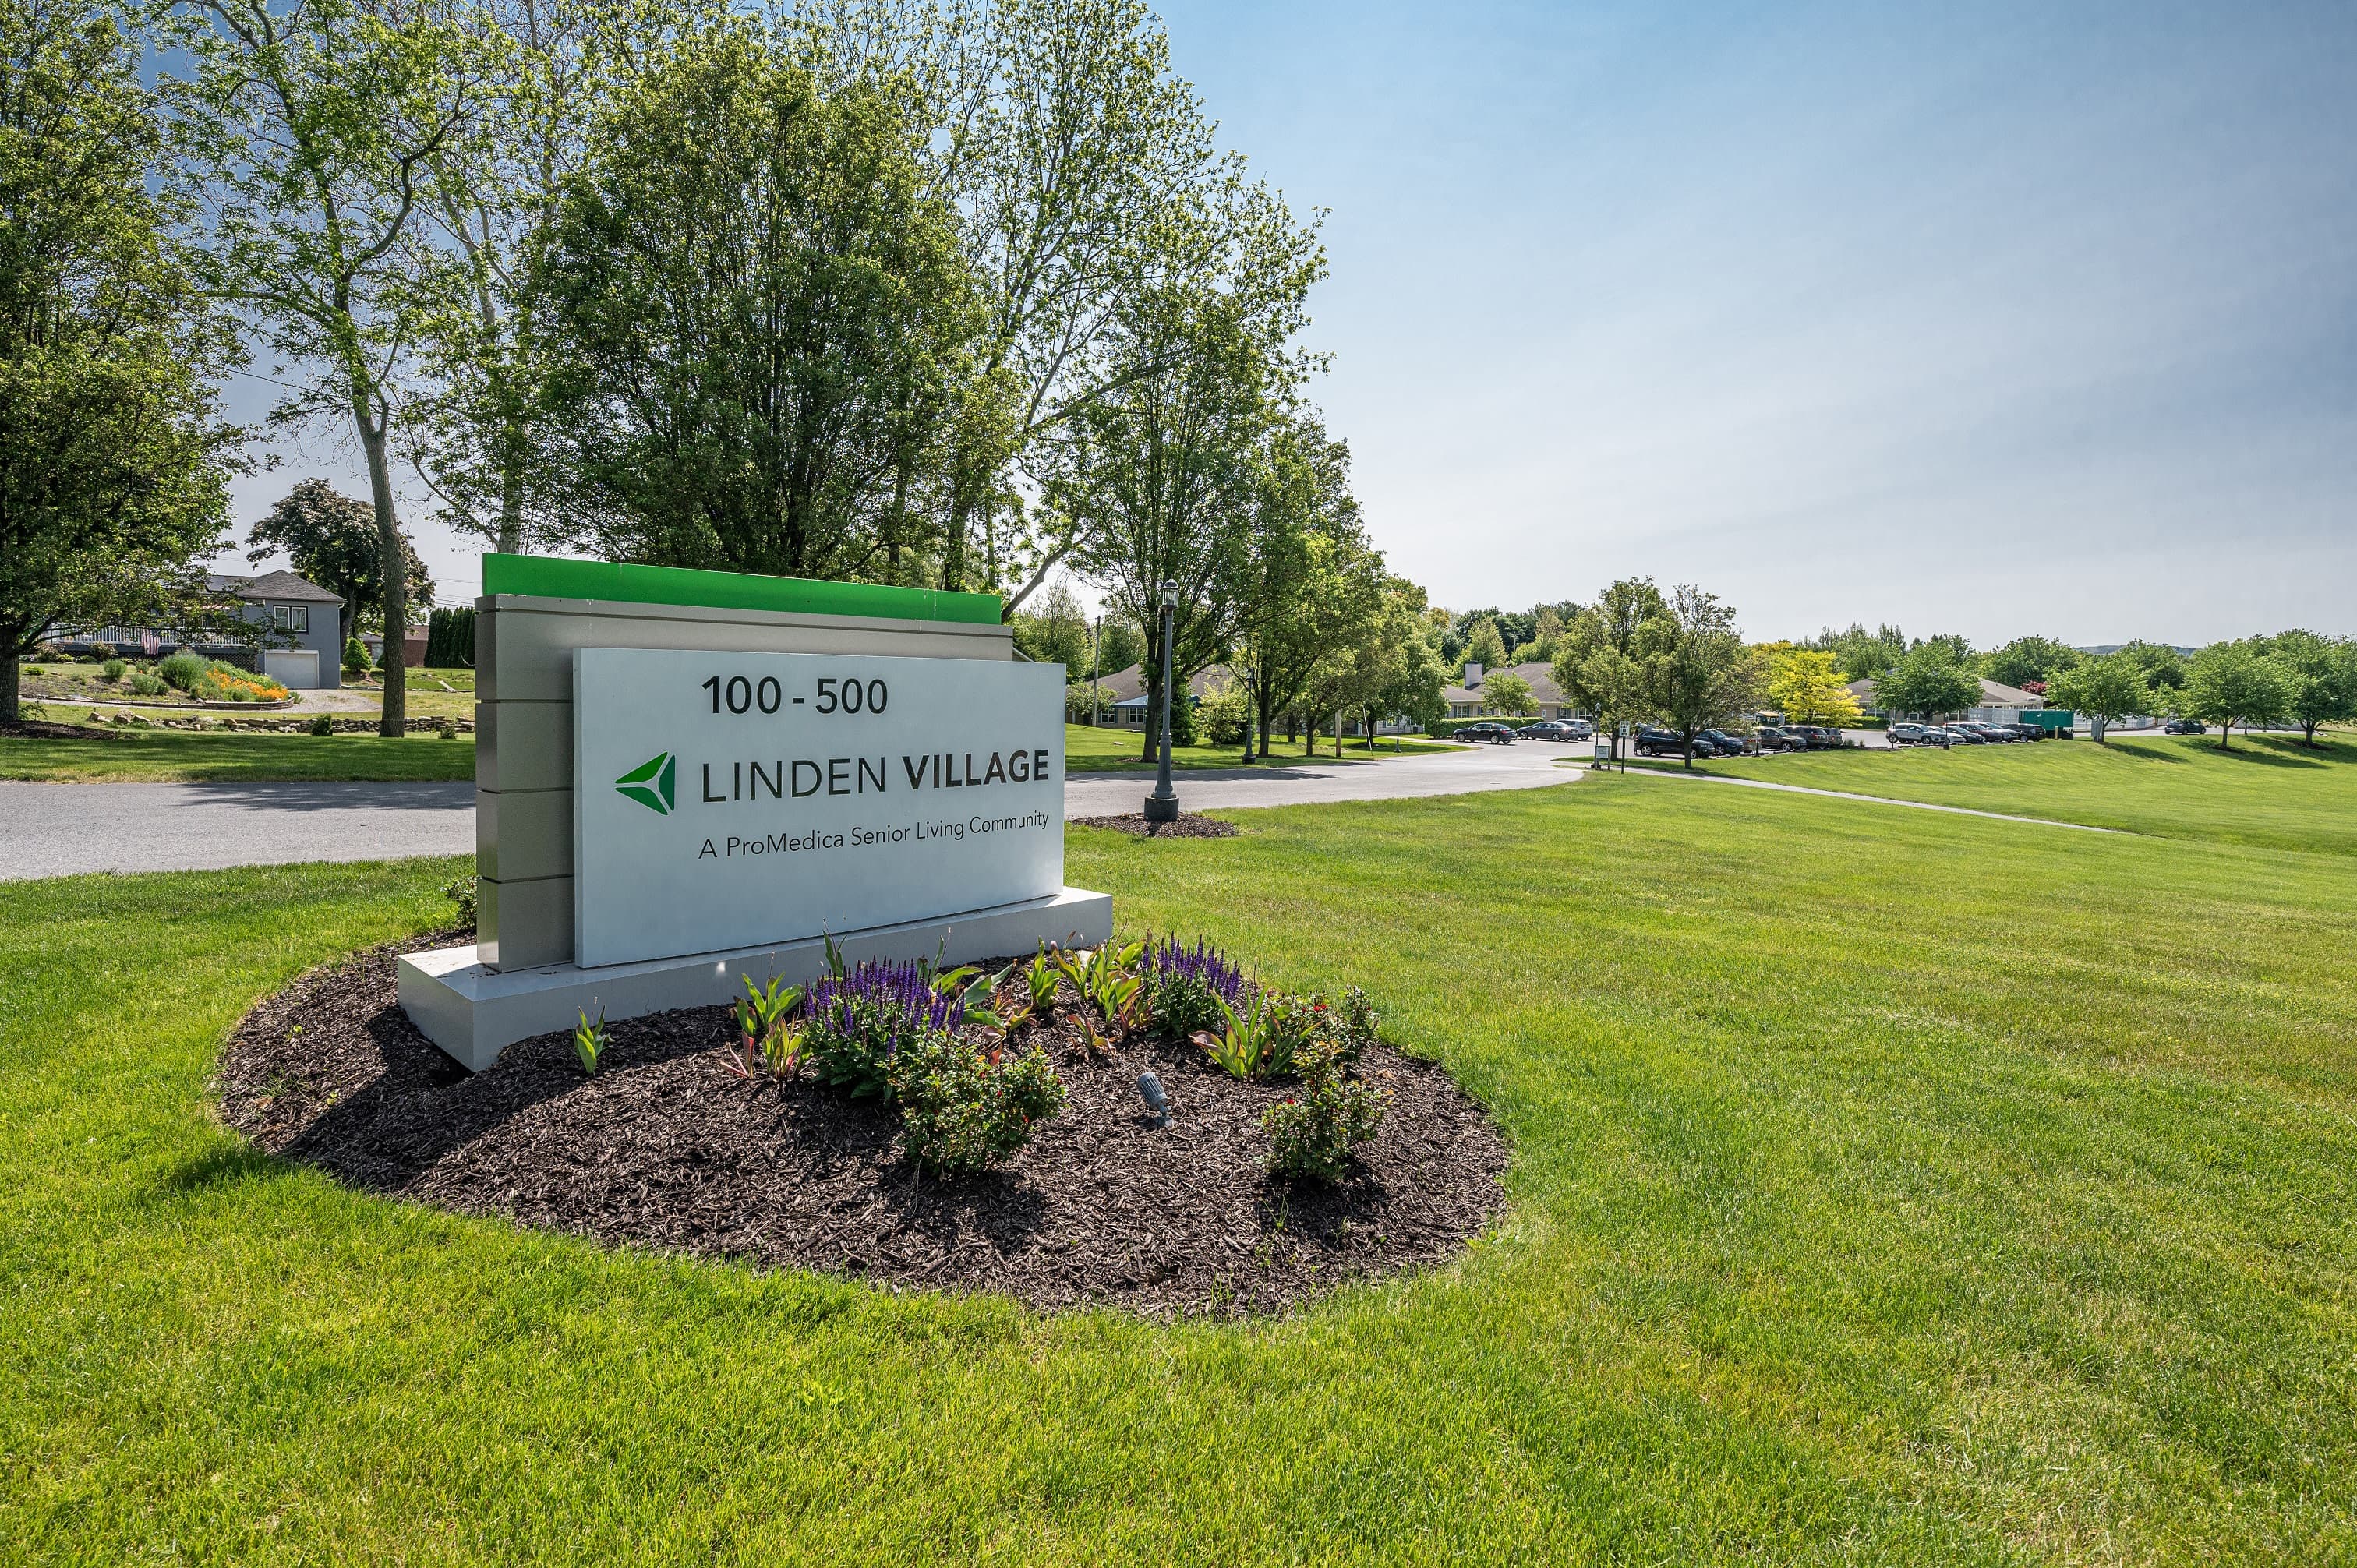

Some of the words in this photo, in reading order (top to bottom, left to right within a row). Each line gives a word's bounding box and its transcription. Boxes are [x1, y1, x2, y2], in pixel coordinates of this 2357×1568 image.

[702, 757, 885, 803] LINDEN
[901, 749, 1049, 790] VILLAGE
[698, 838, 718, 860] A
[726, 828, 844, 857] ProMedica
[851, 825, 911, 846] Senior
[917, 820, 965, 841] Living
[969, 810, 1049, 834] Community
